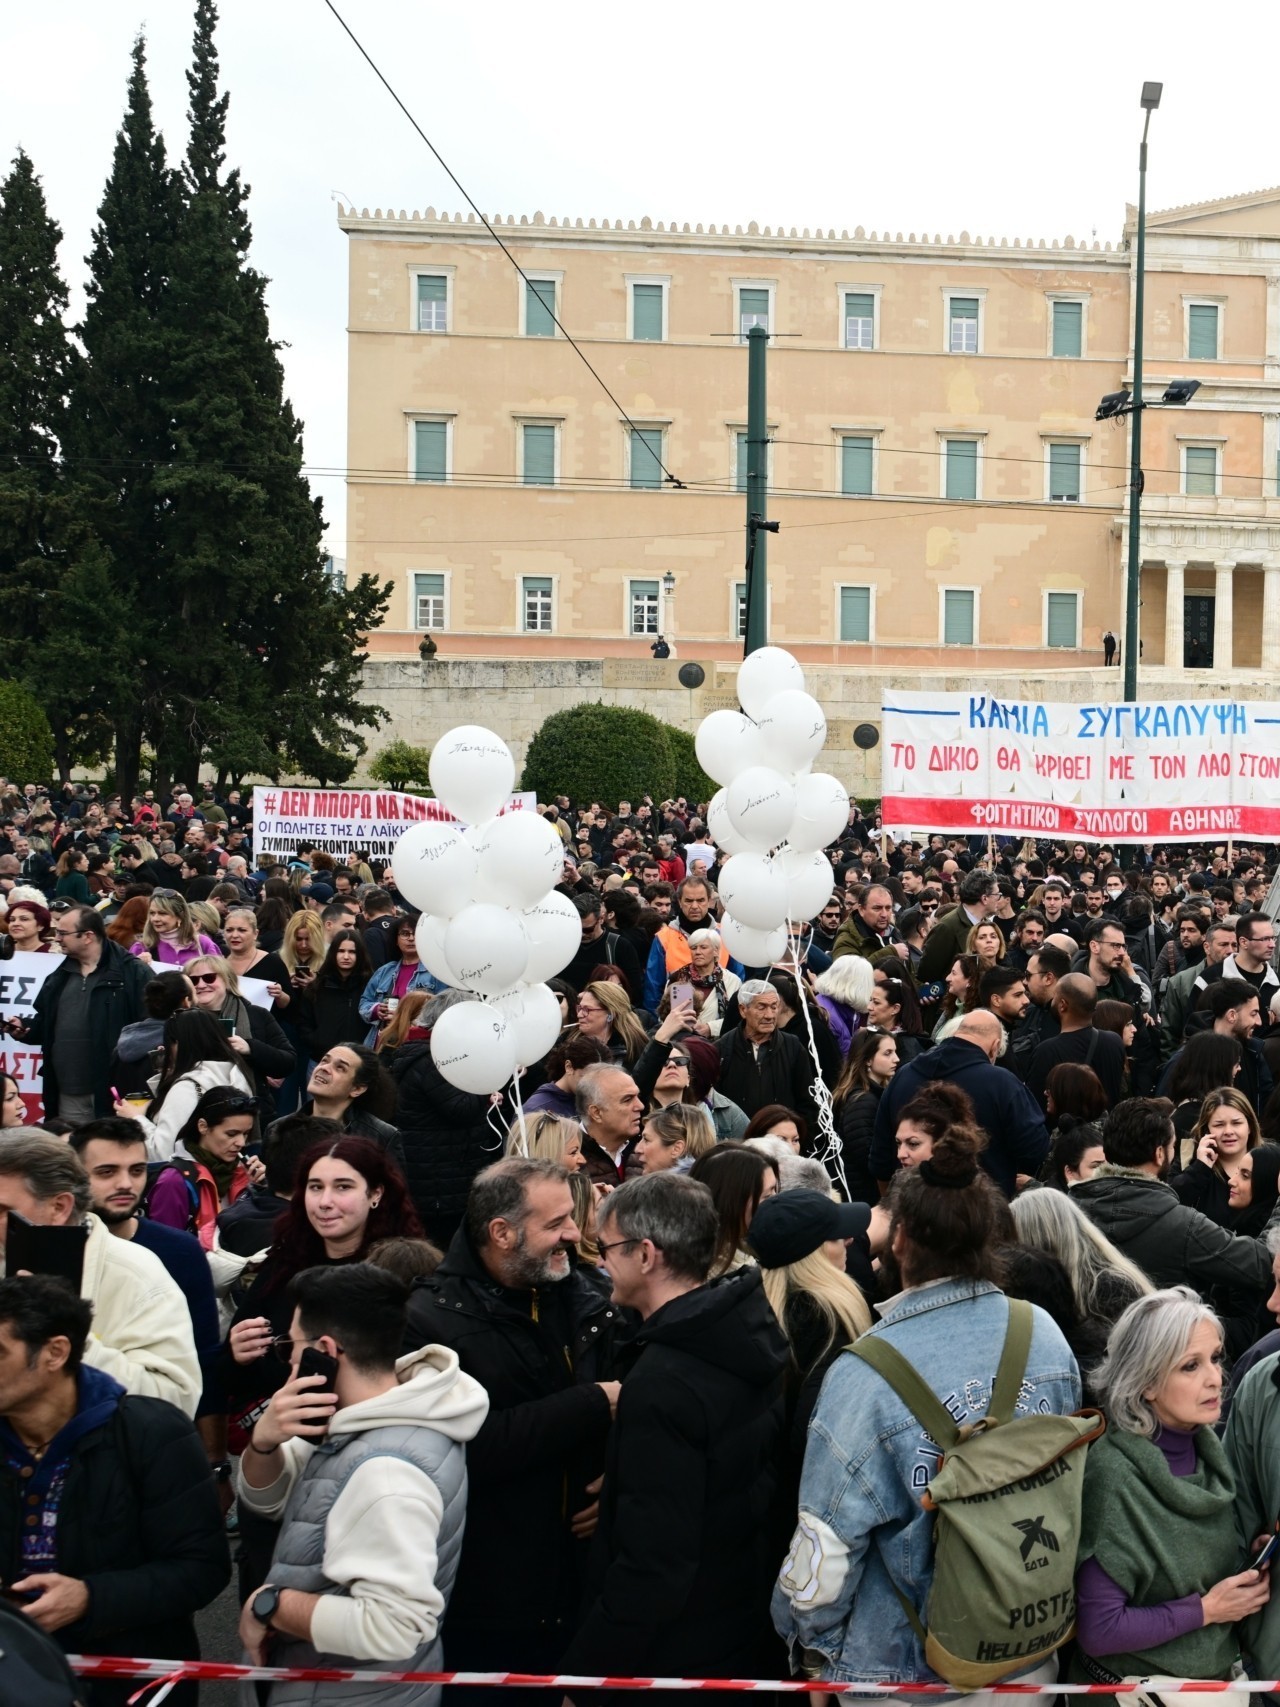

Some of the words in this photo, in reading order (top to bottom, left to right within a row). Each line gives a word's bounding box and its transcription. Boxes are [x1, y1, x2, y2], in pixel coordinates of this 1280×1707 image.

[970, 697, 1049, 737] ΚΑΜΙΑ
[1077, 704, 1246, 738] ΣΥΓΚΑΛΥΨΗ
[891, 743, 916, 770] ΤΟ
[928, 745, 979, 772] ΔΙΚΙΟ
[997, 748, 1021, 772] ΘΑ
[1035, 754, 1091, 780] ΚΡΙΘΕΙ
[1110, 755, 1135, 780] ΜΕ
[1149, 754, 1186, 780] ΤΟΝ
[1198, 753, 1231, 778] ΛΑΟ
[1239, 753, 1280, 779] ΣΤΟΝ
[313, 792, 372, 820] ΜΠΟΡΩ
[376, 794, 400, 820] ΝΑ
[970, 803, 1060, 829] ΦΟΙΤΗΤΙΚΟΙ
[1073, 810, 1148, 833] ΣΥΛΛΟΓΟΙ
[1169, 808, 1242, 832] ΑΘΗΝΑΣ
[258, 821, 272, 833] ΟΙ
[275, 822, 328, 836] ΠΩΛΗΤΕΣ
[331, 824, 353, 837] ΤΗΣ
[370, 823, 410, 838] ΛΑΪΚΗ
